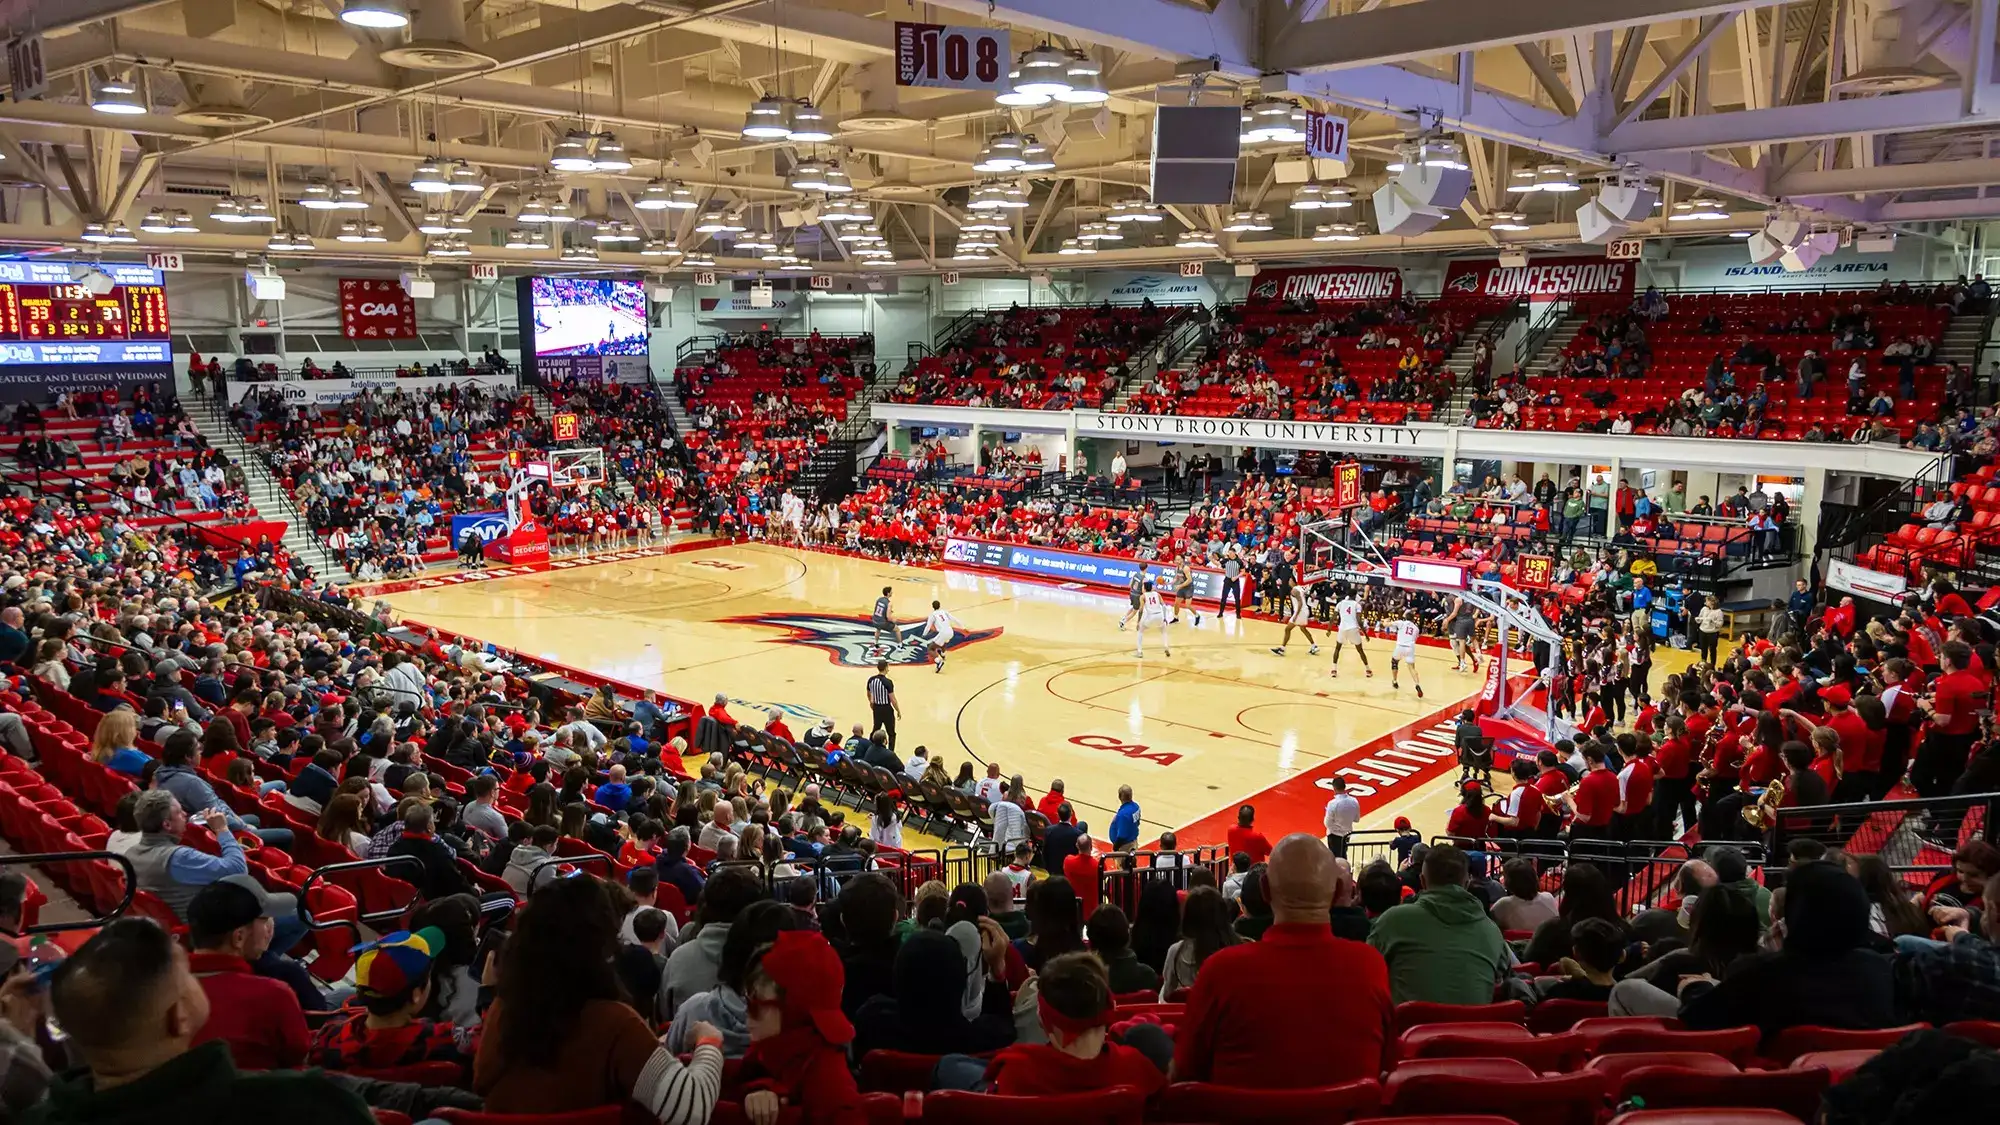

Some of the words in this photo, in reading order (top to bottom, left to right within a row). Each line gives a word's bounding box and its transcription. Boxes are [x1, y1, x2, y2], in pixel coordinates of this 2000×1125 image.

[901, 27, 914, 81] SECTION
[921, 30, 999, 83] 108
[16, 37, 42, 92] 109
[1316, 117, 1344, 155] 107
[1612, 242, 1640, 257] 203
[156, 256, 178, 268] 113
[477, 266, 495, 278] 114
[1184, 263, 1202, 275] 202
[1725, 266, 1782, 276] ISLAND
[1830, 262, 1888, 273] ARENA
[1485, 263, 1625, 294] CONCESSIONS
[1112, 287, 1142, 295] ISLAND
[1167, 285, 1198, 293] ARENA
[1283, 271, 1396, 300] CONCESSIONS
[30, 306, 50, 320] 33
[70, 307, 79, 319] 2
[103, 306, 122, 321] 37
[360, 302, 398, 316] CAA
[31, 323, 40, 335] 6
[47, 323, 56, 335] 3
[96, 323, 105, 335] 3
[113, 324, 122, 334] 4
[538, 358, 550, 367] IT'S
[550, 358, 571, 367] ABOUT
[0, 373, 42, 384] EATRICE
[44, 373, 70, 382] AND
[72, 372, 114, 382] EUGENE
[115, 371, 168, 381] WEIDMAN
[538, 367, 572, 382] TIME
[576, 366, 587, 376] 24
[559, 424, 573, 437] 20
[1096, 415, 1164, 432] STONY
[1175, 418, 1251, 437] BROOK
[1264, 423, 1422, 445] UNIVERSITY
[1341, 480, 1355, 502] 20
[459, 524, 504, 541] SNY
[514, 543, 547, 556] REDEFINE
[691, 560, 746, 571] CAA
[1149, 596, 1157, 605] 14
[1346, 606, 1352, 615] 4
[1405, 626, 1414, 636] 13
[1481, 656, 1501, 701] news12
[1067, 735, 1184, 767] CAA
[980, 787, 989, 798] 5
